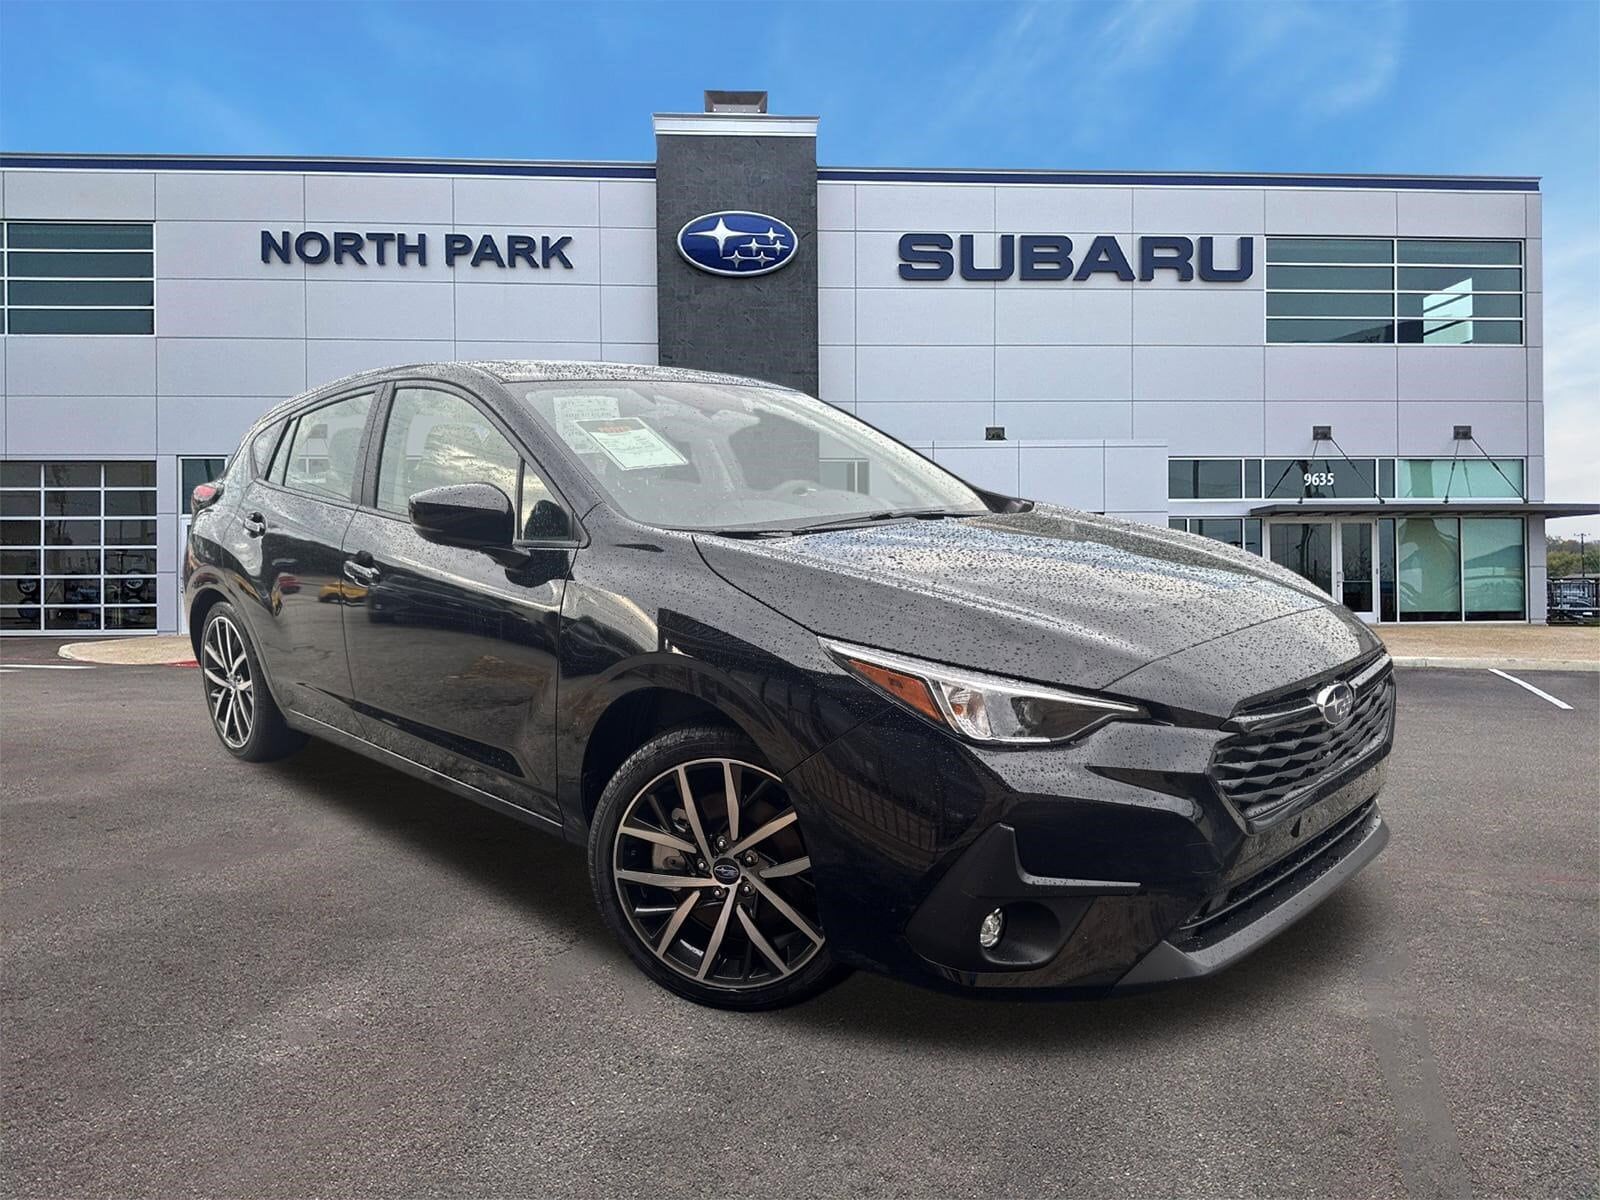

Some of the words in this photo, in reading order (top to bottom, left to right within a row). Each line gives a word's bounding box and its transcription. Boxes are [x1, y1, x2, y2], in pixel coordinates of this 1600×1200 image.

[261, 230, 427, 266] NORTH
[445, 233, 574, 269] PARK
[898, 233, 1254, 282] SUBARU
[1304, 472, 1334, 486] 9635
